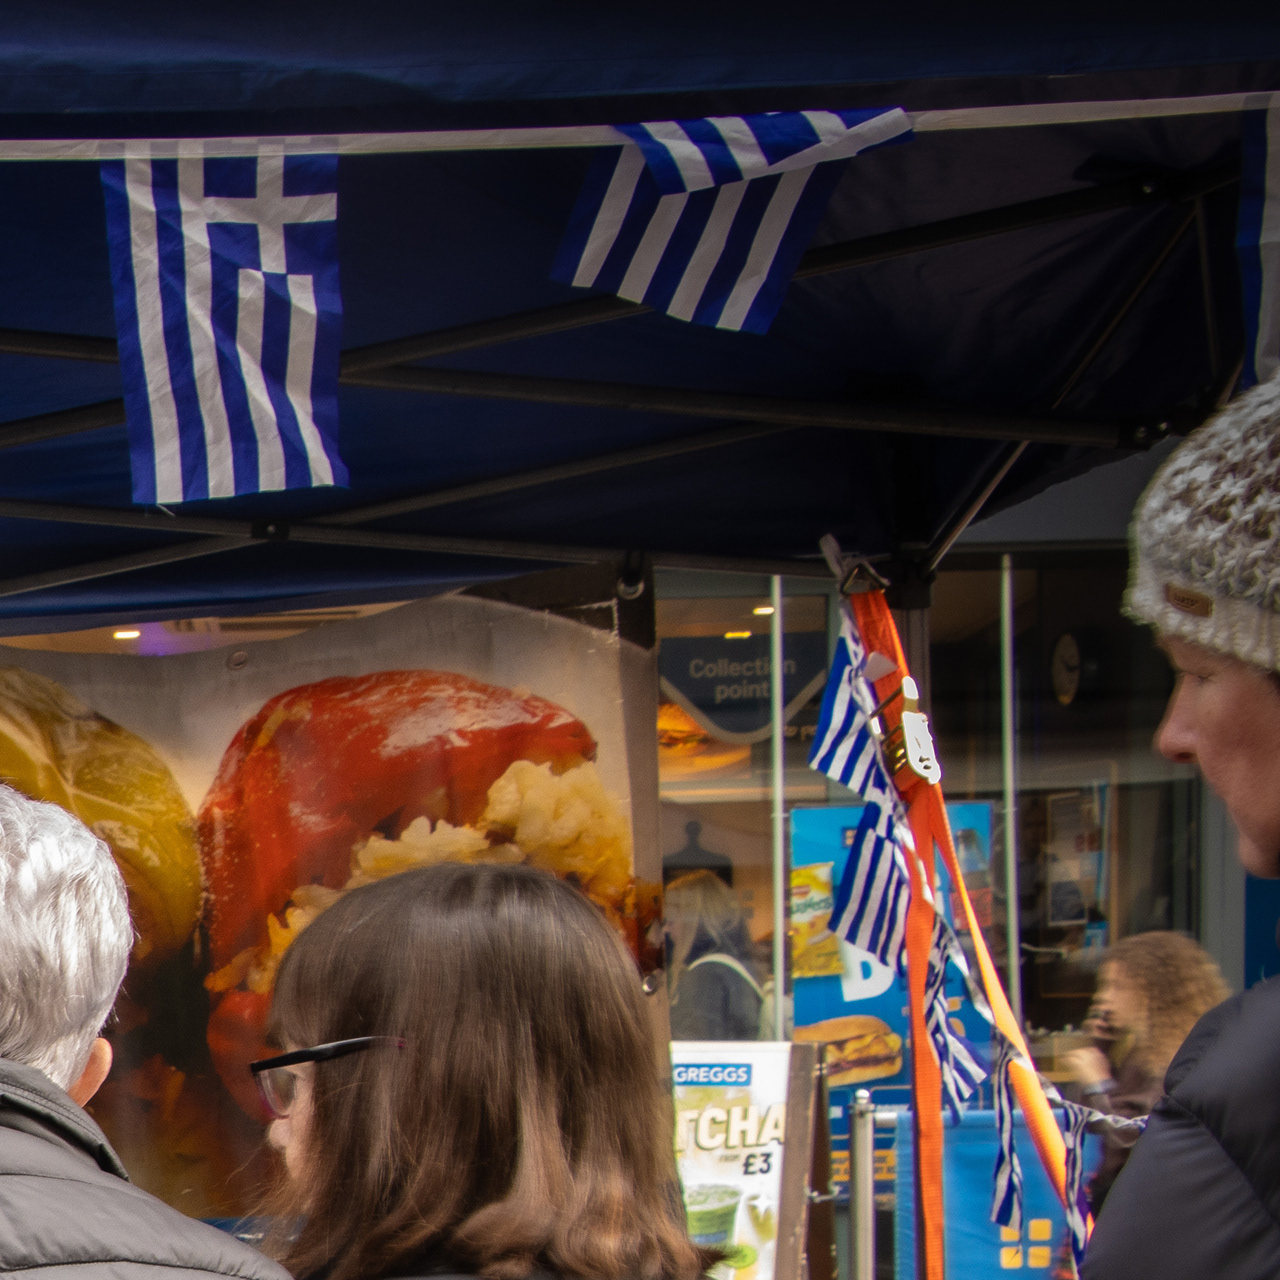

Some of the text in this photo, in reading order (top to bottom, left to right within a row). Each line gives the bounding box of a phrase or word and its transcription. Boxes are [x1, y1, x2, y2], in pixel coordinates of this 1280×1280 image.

[688, 657, 797, 679] Collectin
[715, 680, 771, 704] point
[674, 1067, 748, 1083] GREGGS
[742, 1153, 774, 1175] £3
